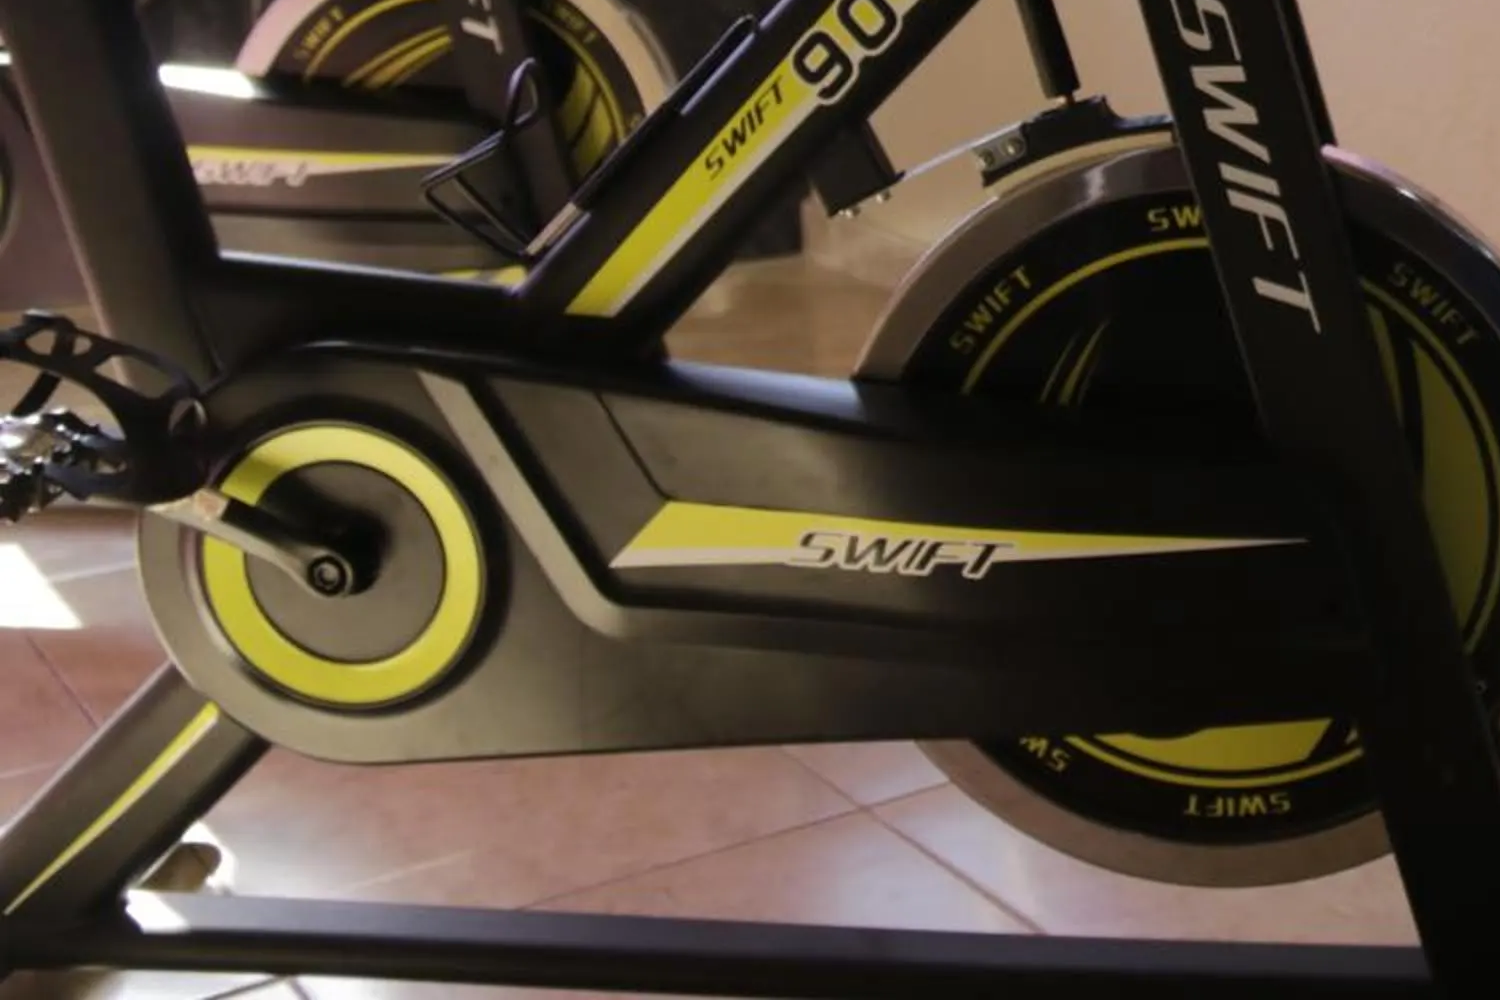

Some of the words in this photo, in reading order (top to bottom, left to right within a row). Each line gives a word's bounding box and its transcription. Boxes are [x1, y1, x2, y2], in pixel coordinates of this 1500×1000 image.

[703, 74, 784, 182] SWIFT
[951, 265, 1033, 354] SWIFT
[1387, 261, 1479, 345] SWIFT
[785, 530, 1016, 579] SWIFT
[1183, 791, 1292, 818] SWIFT
